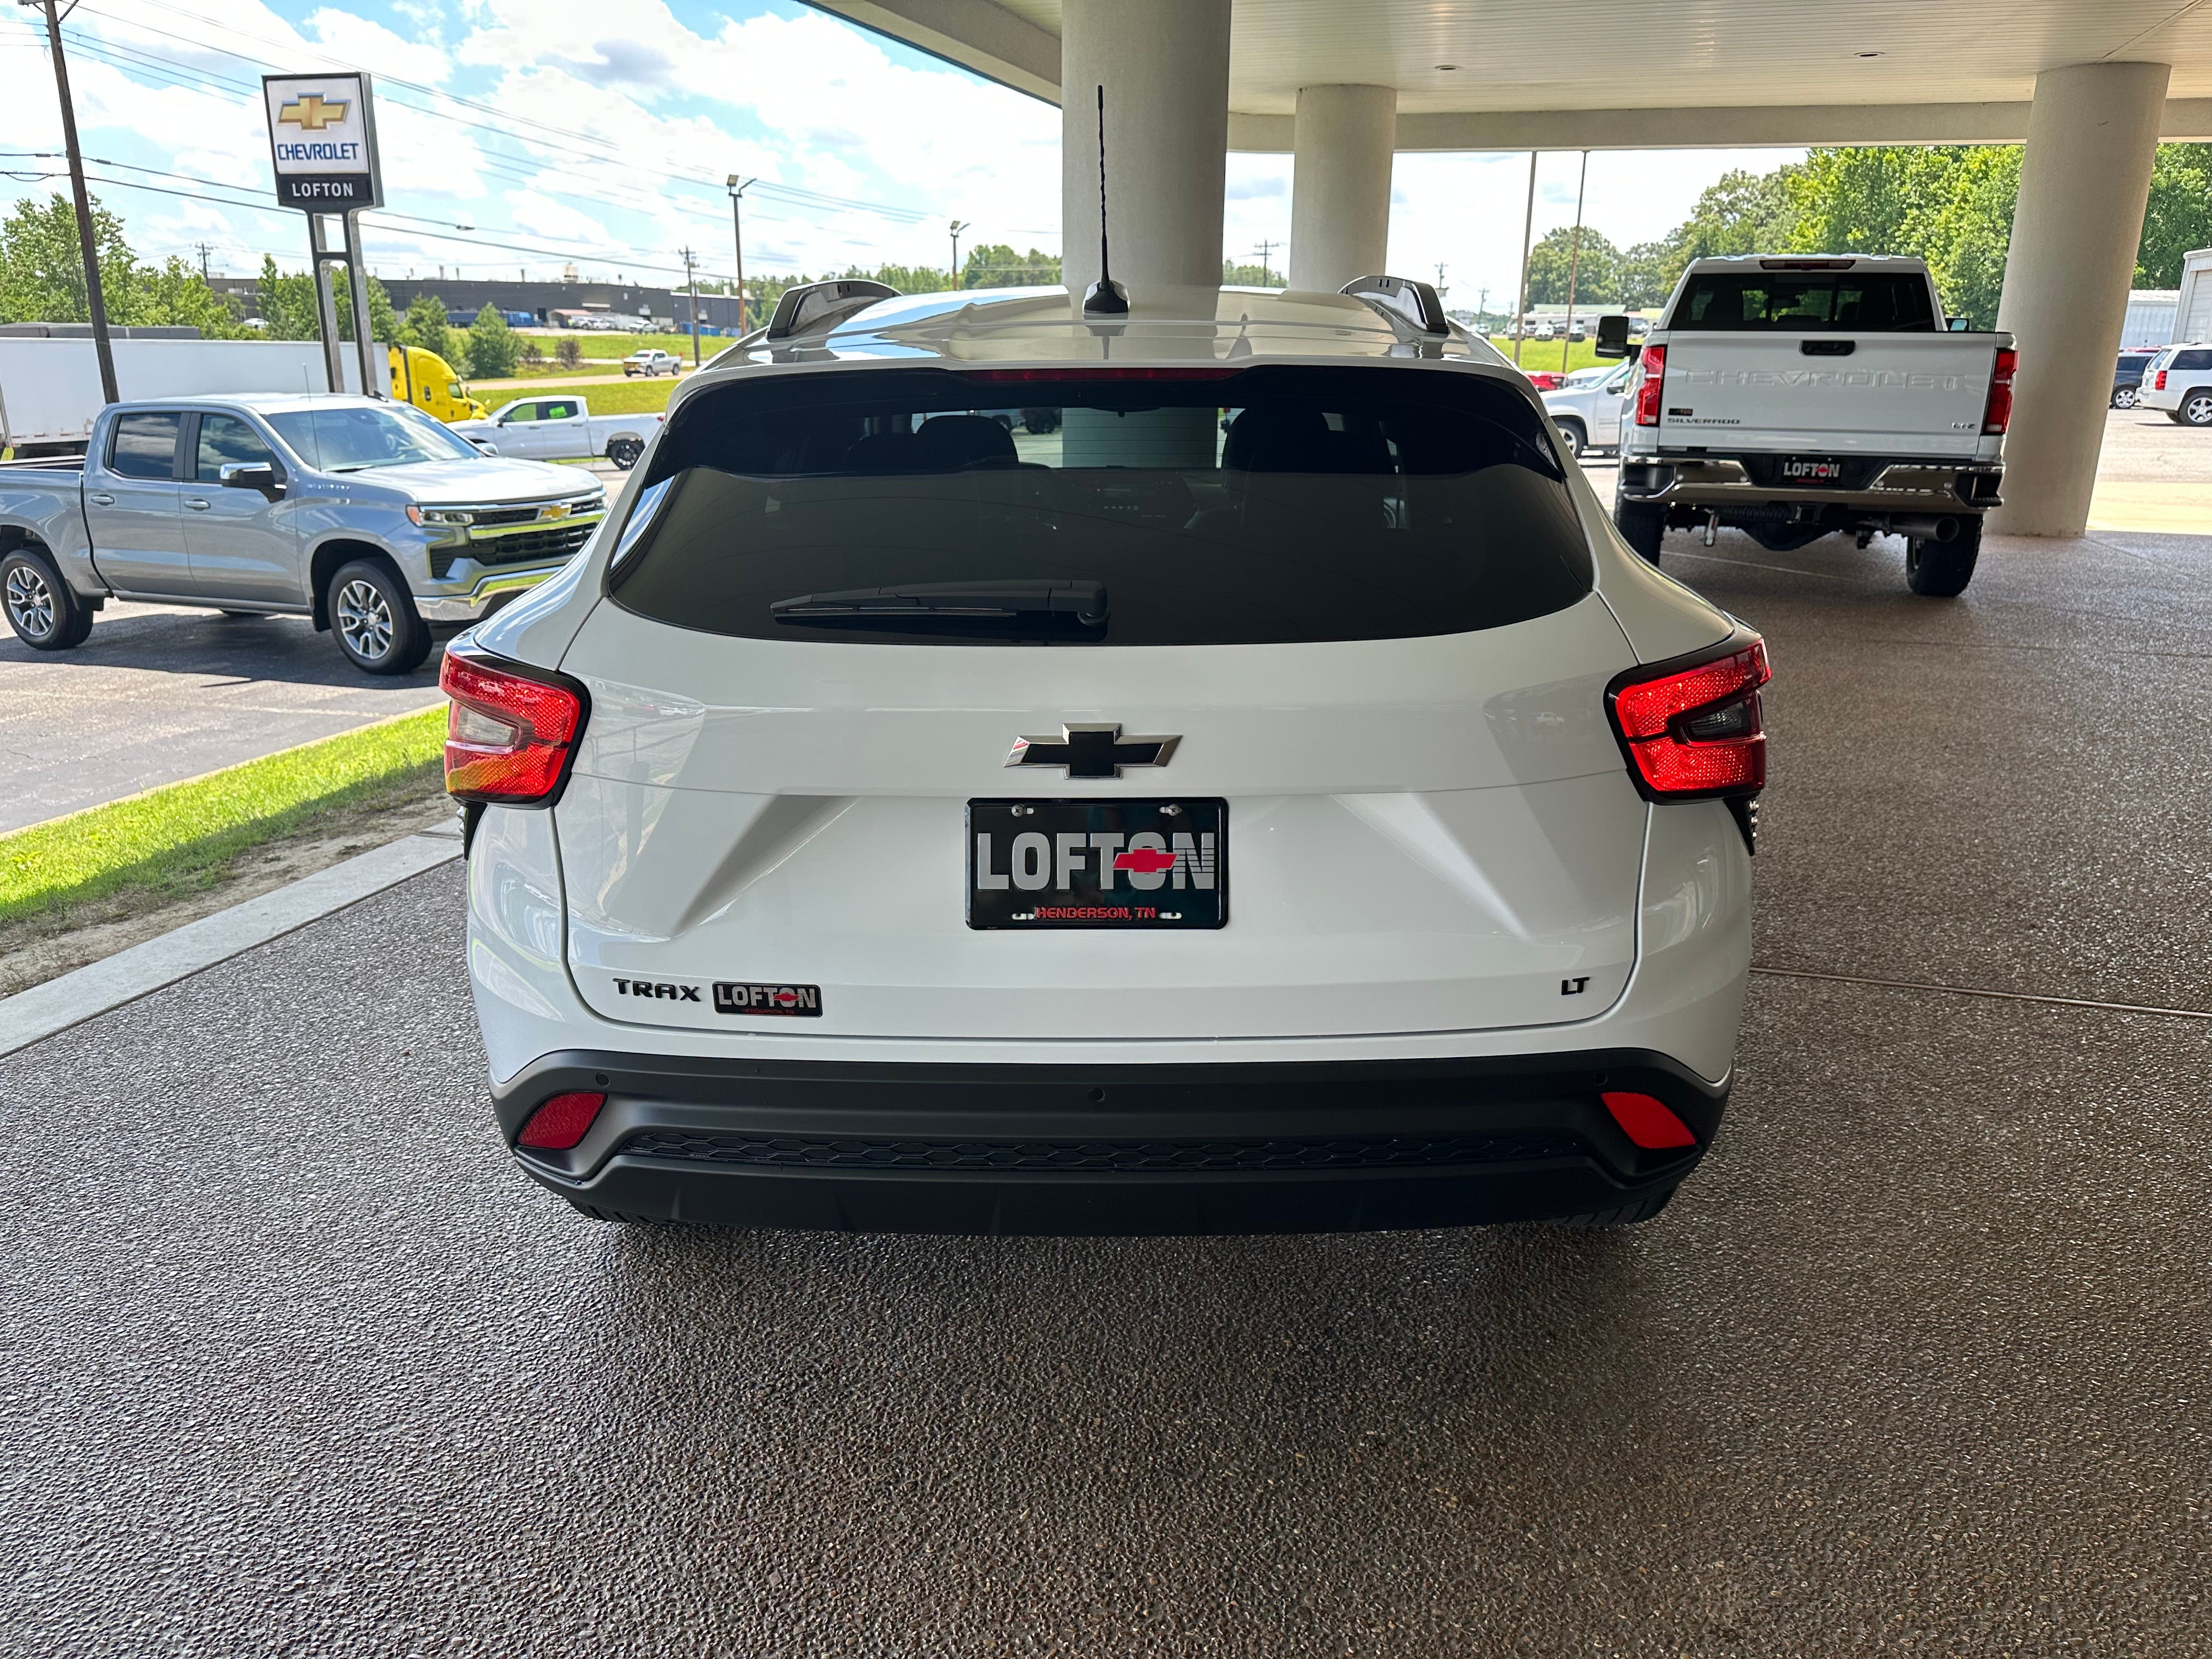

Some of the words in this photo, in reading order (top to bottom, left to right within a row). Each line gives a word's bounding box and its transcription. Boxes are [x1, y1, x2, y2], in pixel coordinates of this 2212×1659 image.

[277, 143, 359, 160] CHEVROLET
[291, 182, 354, 198] LOFTON
[1685, 369, 1967, 390] CHEVROLET
[1783, 462, 1841, 478] LOFTON
[977, 832, 1215, 890] LOFTON
[1035, 907, 1132, 921] HENDERSON,
[1135, 907, 1156, 918] TN
[612, 978, 701, 1002] TRAX
[1561, 977, 1590, 996] LT
[717, 985, 817, 1008] LOFTON
